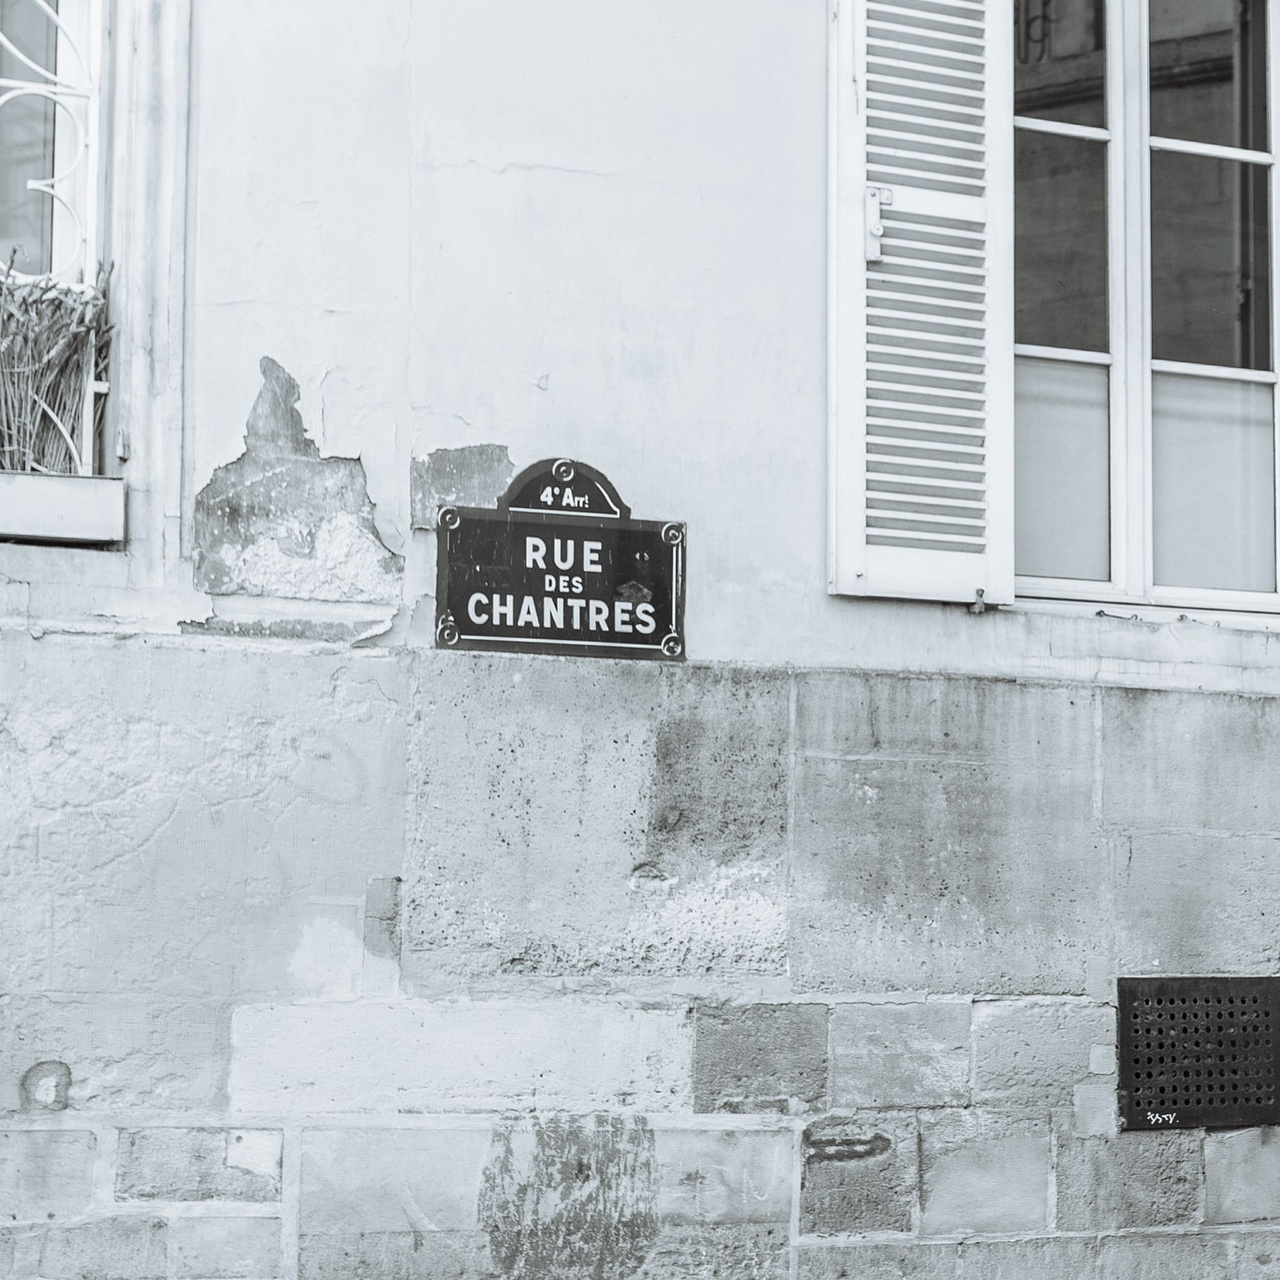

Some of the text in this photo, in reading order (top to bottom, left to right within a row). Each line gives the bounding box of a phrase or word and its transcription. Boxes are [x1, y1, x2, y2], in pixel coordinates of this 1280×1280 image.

[525, 536, 602, 573] RUE
[545, 574, 583, 594] DES
[468, 592, 657, 634] CHANTRES
